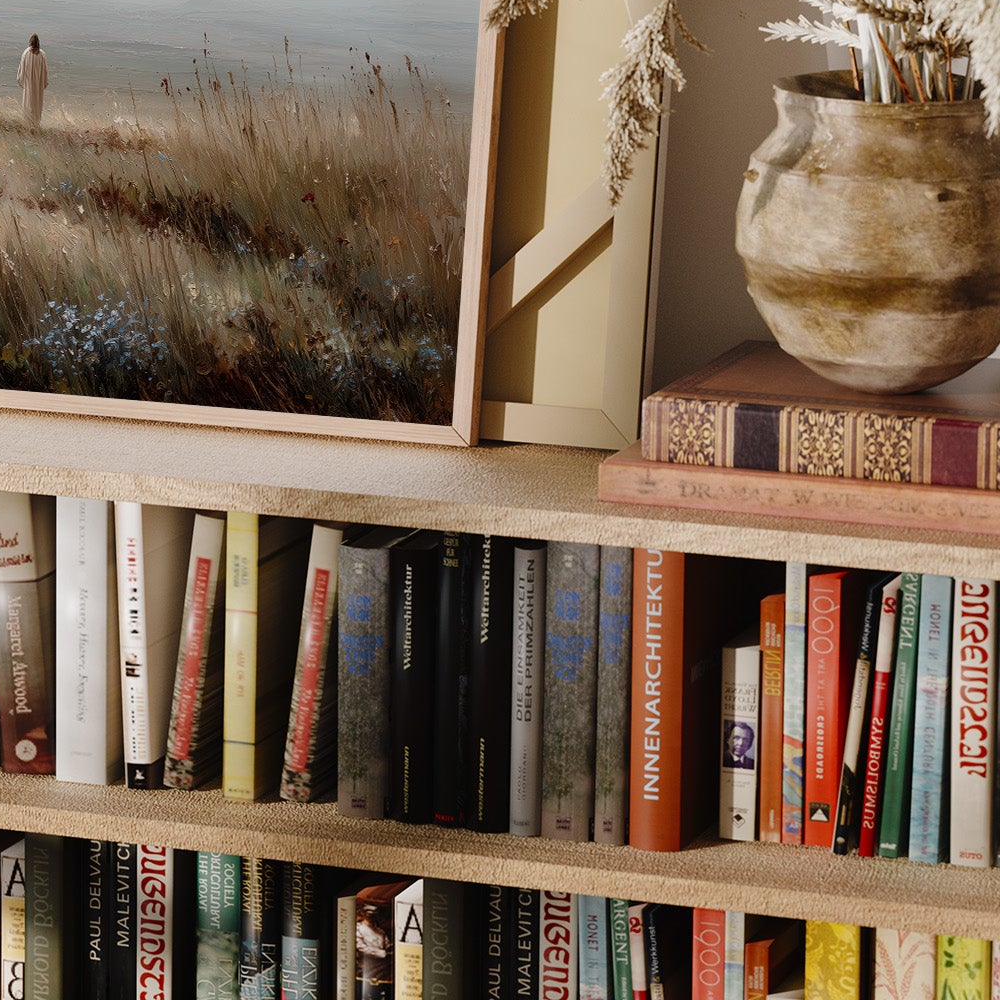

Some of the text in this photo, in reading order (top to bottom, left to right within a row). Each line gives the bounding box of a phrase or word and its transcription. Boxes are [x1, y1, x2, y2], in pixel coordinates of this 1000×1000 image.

[6, 595, 32, 714] Margaret Atwood
[403, 564, 412, 670] Weltarchitektur
[516, 573, 525, 721] DIE EINSAMKEIT
[524, 559, 535, 722] DER PRIMZAHLEN
[643, 549, 663, 801] INNENARCHITEKTU
[478, 737, 486, 821] westermann
[90, 840, 101, 960] PAUL DELVAU
[489, 886, 502, 956] DELVAU
[588, 915, 598, 951] MONET
[612, 899, 628, 965] ARGENT
[650, 926, 661, 973] Werkkunst
[695, 922, 721, 987] 1900
